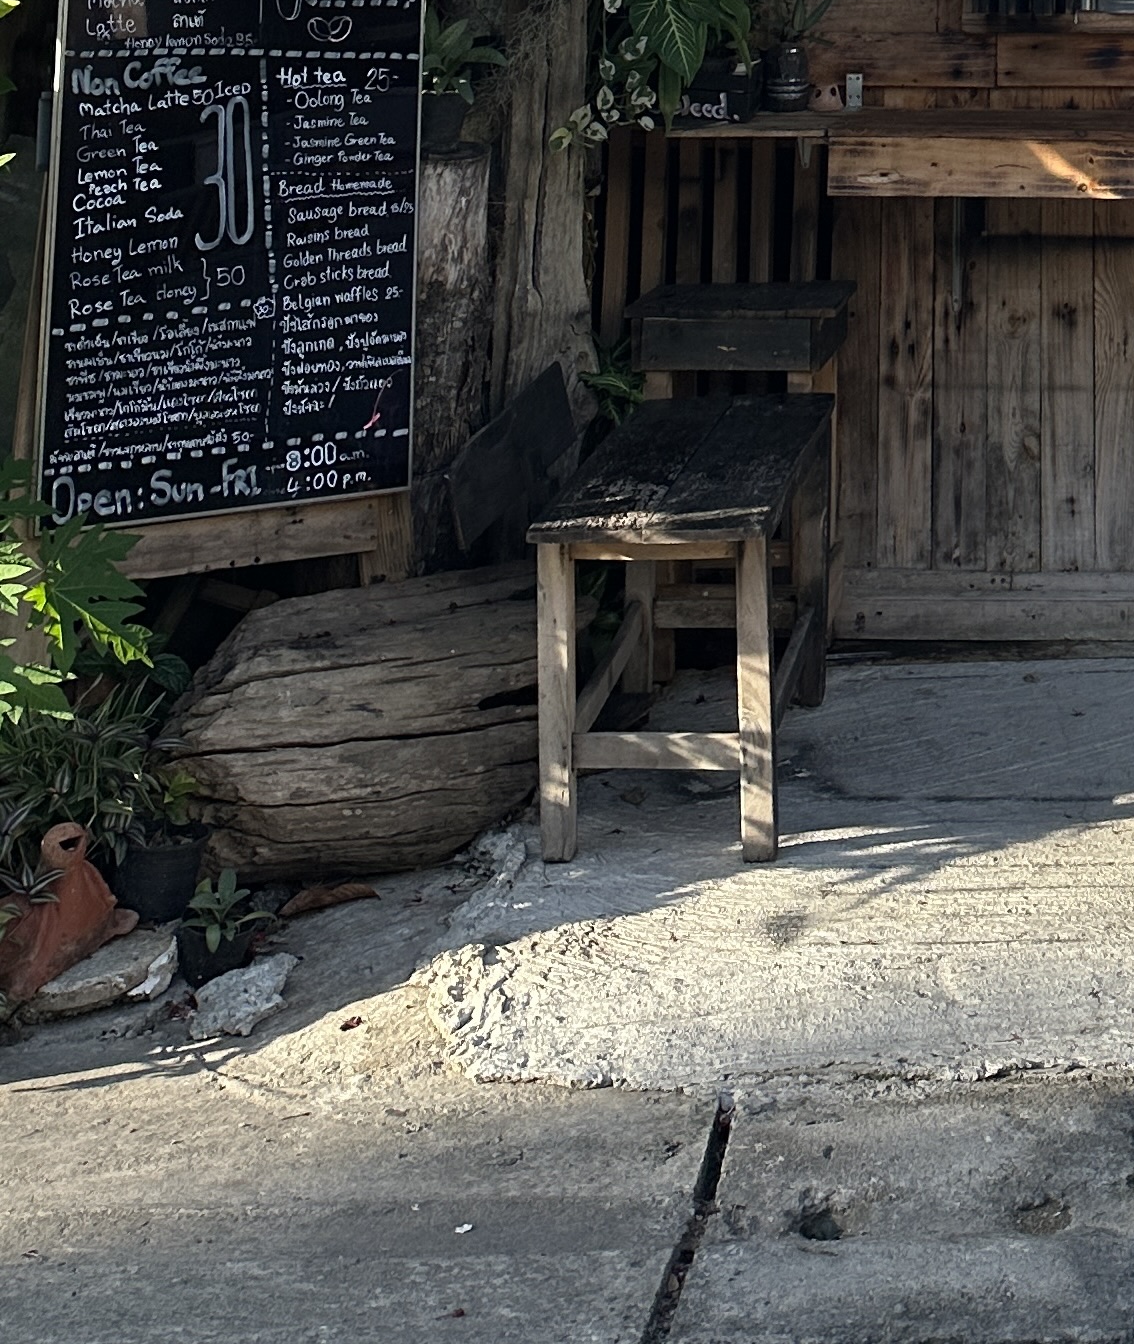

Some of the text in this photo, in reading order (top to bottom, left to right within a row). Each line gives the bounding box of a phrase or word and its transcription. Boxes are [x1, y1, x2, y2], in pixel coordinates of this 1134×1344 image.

[72, 57, 208, 96] Non Coffee
[276, 66, 308, 86] Hot
[313, 66, 346, 84] tea
[79, 97, 142, 117] Matcha
[148, 89, 190, 111] Latte
[350, 88, 372, 105] Tea
[79, 118, 147, 141] Thai Tea
[293, 112, 370, 130] Jasmine Tea
[76, 134, 159, 163] Green Tea
[292, 132, 397, 149] Jasmine Green Tea
[77, 155, 163, 185] Lemon Tea
[293, 151, 335, 167] Ginger
[372, 149, 394, 161] Tea
[88, 177, 163, 196] Peach Tea
[194, 95, 255, 252] 30
[278, 177, 393, 197] Bread Homemade
[72, 193, 127, 213] Cocoa
[287, 200, 387, 224] Sausage bread
[72, 205, 185, 240] Italian Soda
[334, 223, 370, 240] bread
[70, 235, 179, 266] Honey Lemon
[283, 234, 408, 269] Golden Threads bread
[69, 254, 246, 290] Rose Tea milk 50
[283, 271, 317, 290] Crab
[320, 264, 354, 284] sticks
[68, 297, 114, 320] Rose
[119, 289, 148, 307] Tea
[282, 293, 331, 313] Belgian
[334, 285, 379, 304] waffles
[286, 441, 337, 472] 8:00
[150, 468, 204, 506] Sun
[286, 470, 338, 498] 4:00
